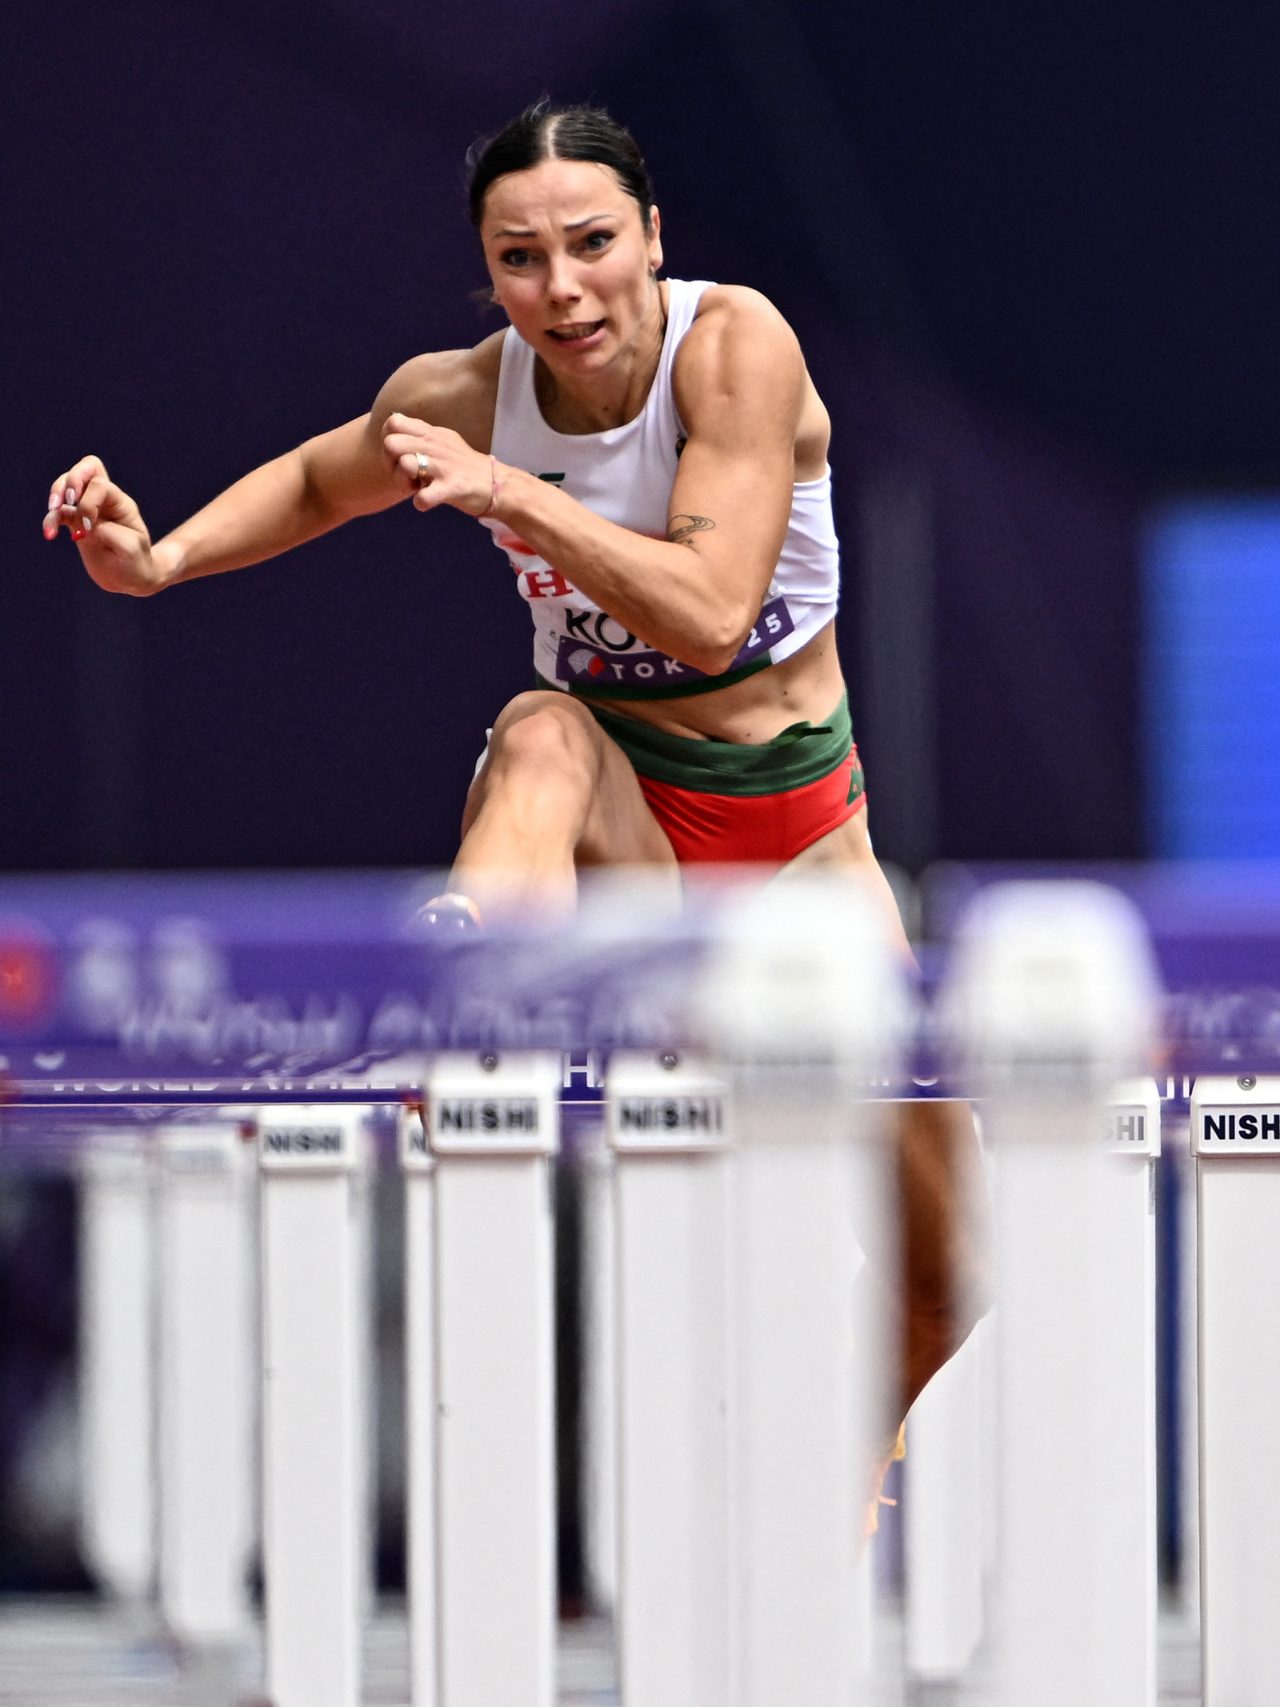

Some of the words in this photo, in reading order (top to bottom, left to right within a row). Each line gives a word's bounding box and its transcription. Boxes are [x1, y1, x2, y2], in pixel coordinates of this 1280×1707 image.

[565, 607, 652, 652] KO
[610, 659, 684, 680] TOK
[440, 1106, 539, 1131] NISHI
[620, 1106, 723, 1131] NISHI
